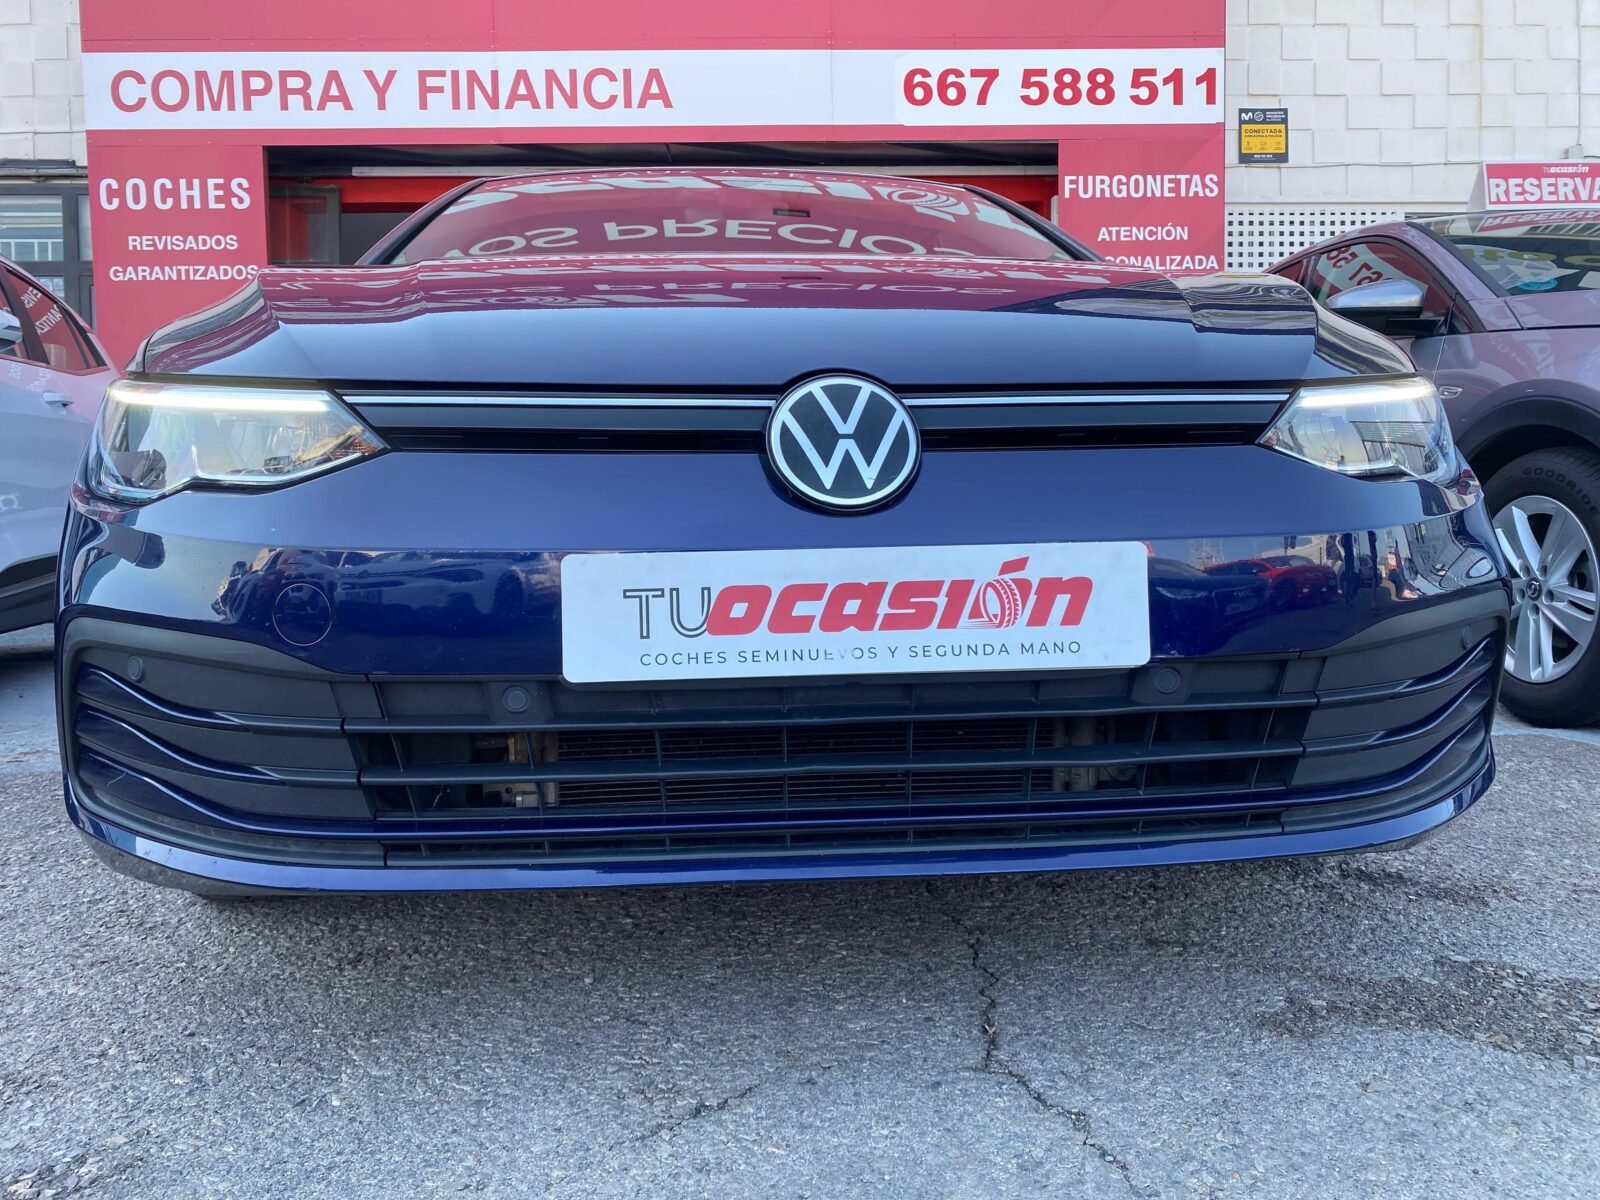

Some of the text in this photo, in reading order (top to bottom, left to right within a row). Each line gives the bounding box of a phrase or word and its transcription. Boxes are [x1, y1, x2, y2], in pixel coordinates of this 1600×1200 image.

[110, 67, 674, 113] COMPRA Y FINANCIA
[903, 67, 1217, 106] 667 588 511
[99, 177, 251, 210] COCHES
[1064, 173, 1219, 199] FURGONETAS
[127, 234, 239, 251] REVISADOS
[1097, 222, 1189, 242] ATENCIÓN
[109, 264, 259, 282] GARANTIZADOS
[1104, 255, 1219, 270] ONALIZADA
[640, 640, 1082, 667] COCHES SEMINUEVOS Y SEGUNDA MANO
